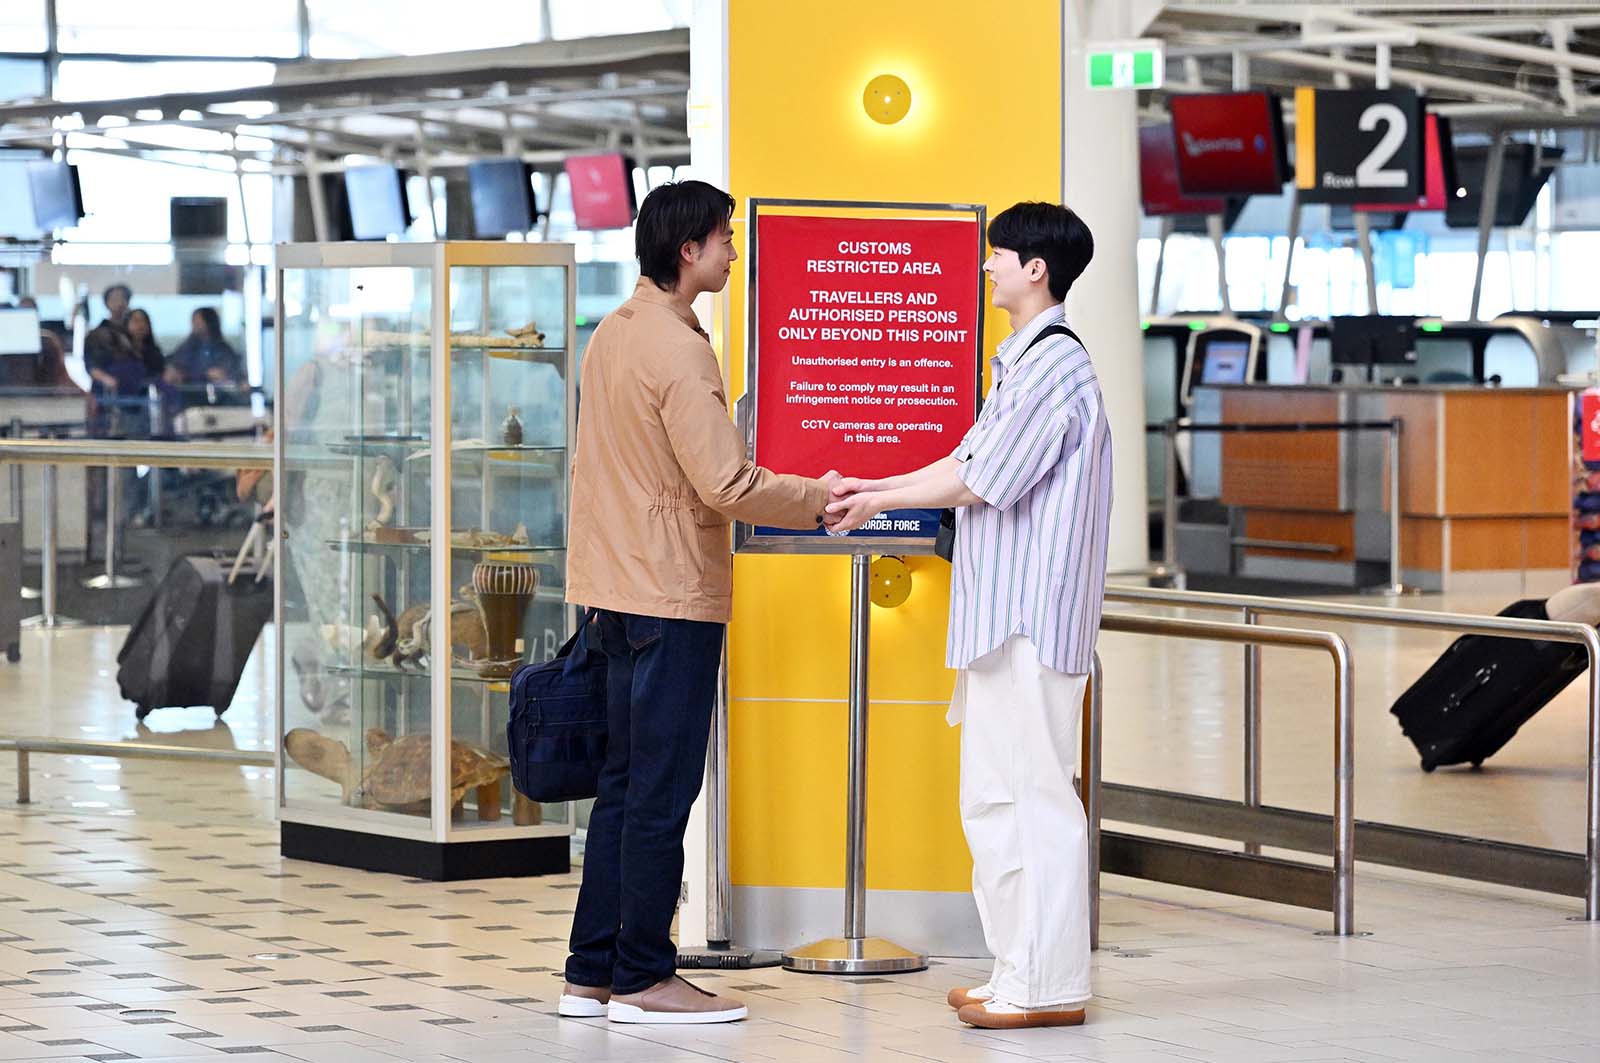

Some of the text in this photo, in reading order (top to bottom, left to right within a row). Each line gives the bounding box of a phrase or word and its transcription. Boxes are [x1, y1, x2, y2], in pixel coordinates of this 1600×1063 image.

[1323, 103, 1408, 188] Row 2
[838, 241, 912, 256] CUSTOMS
[806, 260, 942, 275] RESTRICTED AREA
[809, 291, 938, 306] TRAVELLERS AND
[788, 308, 958, 324] AUTHORISED PERSONS
[778, 327, 968, 343] ONLY BEYOND THIS POINT
[791, 356, 953, 369] Unauthorised entry is an offence.
[789, 381, 955, 395] Failure to comply may result in an
[785, 394, 958, 408] infringement notice or prosecution.
[801, 419, 943, 433] CCTV cameras are operating
[843, 433, 901, 444] in this area.
[893, 520, 920, 532] FORCE
